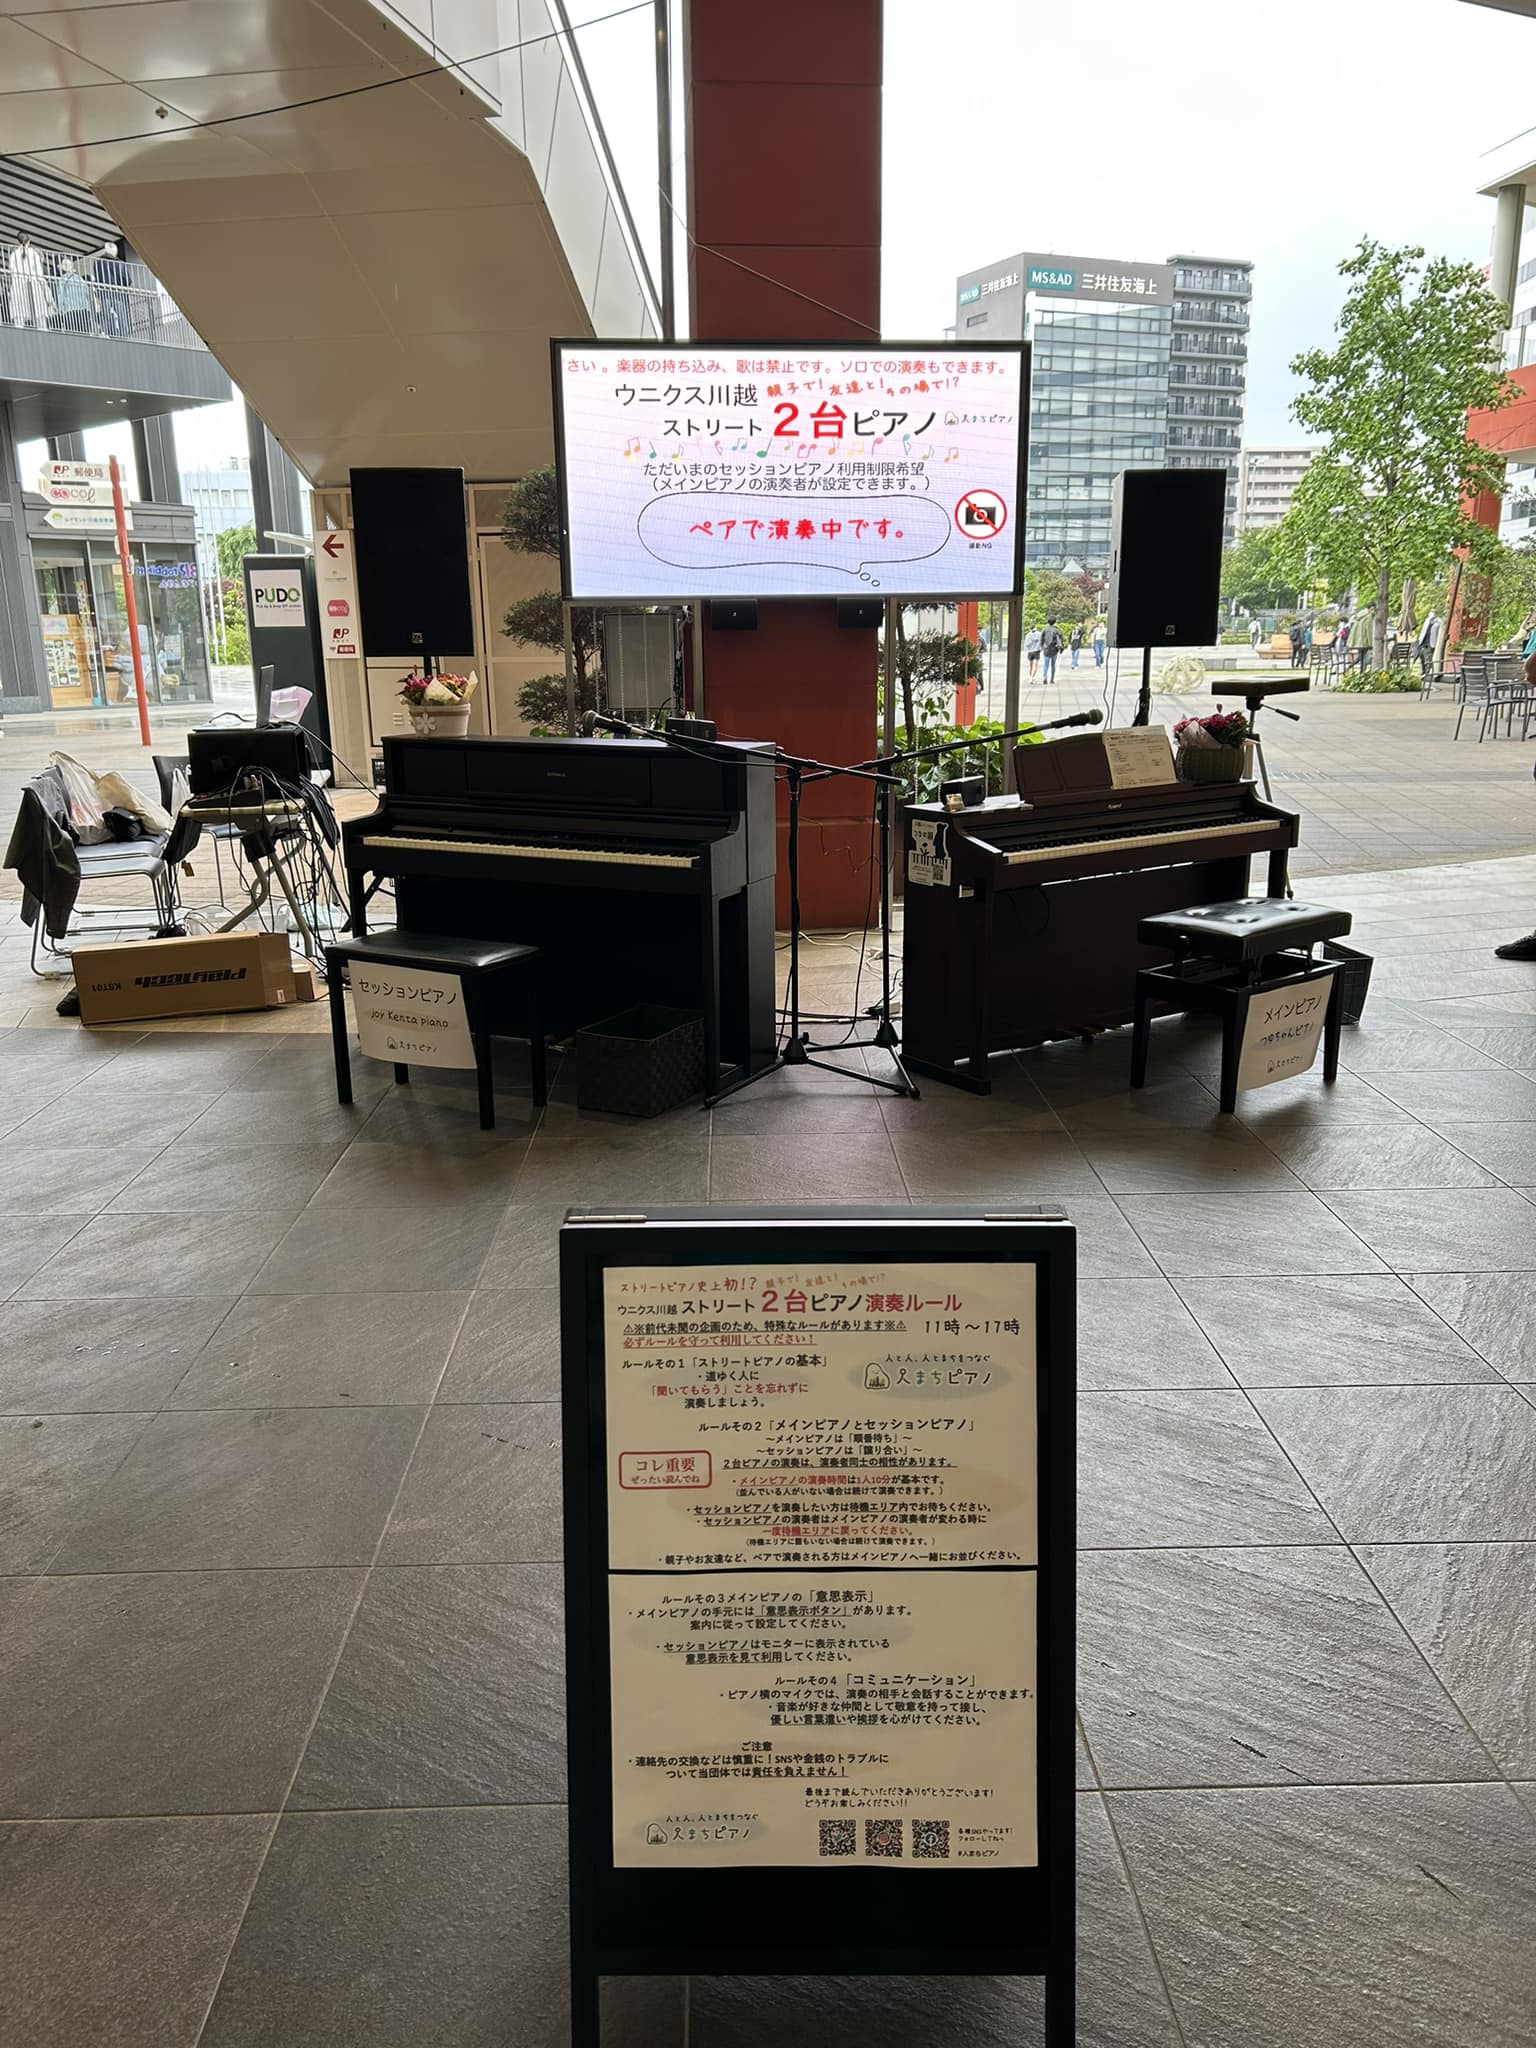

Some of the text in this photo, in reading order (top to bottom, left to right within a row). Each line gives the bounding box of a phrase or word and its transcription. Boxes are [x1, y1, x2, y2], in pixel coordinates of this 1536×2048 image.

[981, 273, 1020, 296] 三井住友海上
[1031, 270, 1073, 286] MS&AD
[1081, 273, 1158, 296] 三井住友海上
[615, 384, 759, 407] ウニクス川越
[643, 462, 925, 477] ただいまのセッションピアノ利用制限希望
[689, 517, 905, 541] ペアで演奏中です。
[255, 587, 301, 603] PUDO
[91, 983, 122, 993] KST01
[359, 978, 457, 1005] セッションピアノ
[388, 1009, 418, 1025] Kenta
[421, 1016, 449, 1028] piano
[1264, 996, 1322, 1025] メインピアノ
[617, 1304, 678, 1316] ウニクス川越
[636, 1456, 696, 1473] コレ重要
[690, 1618, 846, 1631] 案内に従って設定してください。
[741, 1740, 773, 1752] ご注意
